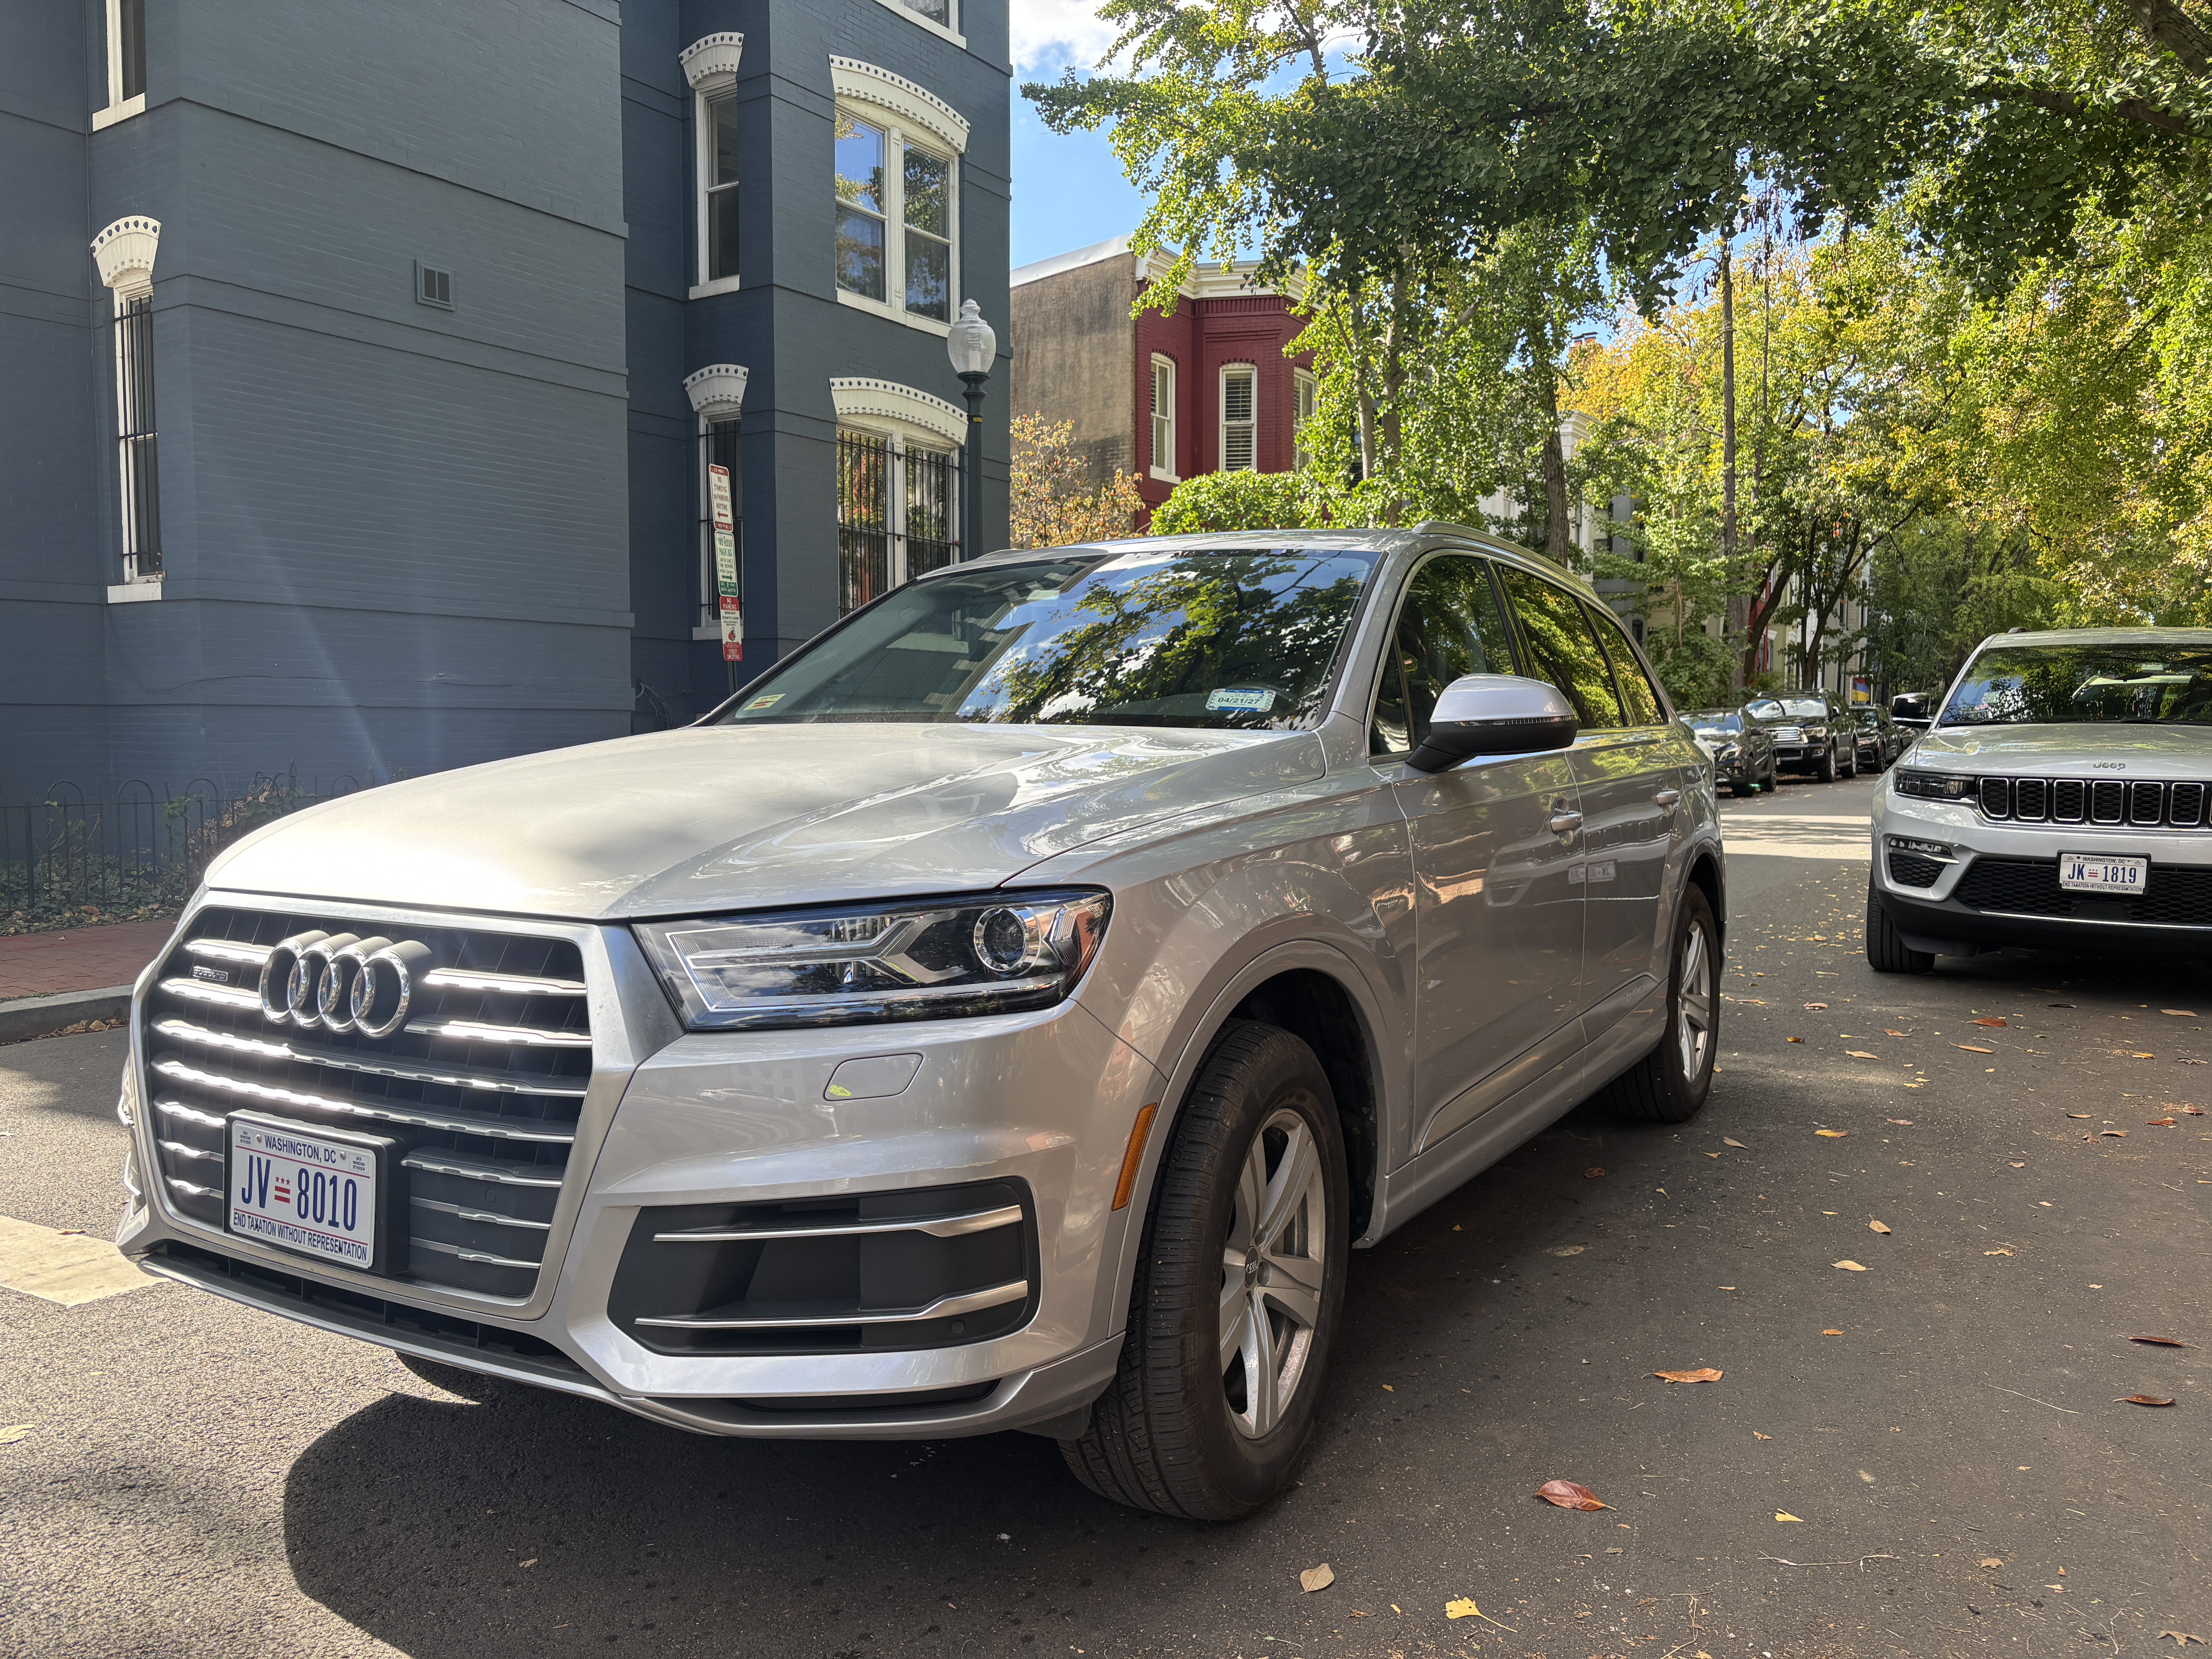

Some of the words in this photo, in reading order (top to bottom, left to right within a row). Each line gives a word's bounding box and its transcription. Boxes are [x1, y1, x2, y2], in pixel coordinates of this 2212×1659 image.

[714, 484, 727, 493] STANDING
[717, 494, 729, 502] PARKING
[716, 503, 727, 511] ANYTIME
[720, 548, 732, 557] PARKING
[2093, 761, 2126, 770] Jeep
[2068, 863, 2085, 880] JK
[2102, 866, 2136, 884] 1819
[265, 1135, 321, 1163] WASHINGTON,
[324, 1150, 336, 1163] DC
[241, 1155, 271, 1209] JV
[297, 1168, 357, 1231] 8010
[234, 1211, 246, 1228] END
[247, 1215, 276, 1237] TAXATION
[278, 1224, 306, 1244] WITHOUT
[308, 1232, 367, 1262] REPRESENTATION
